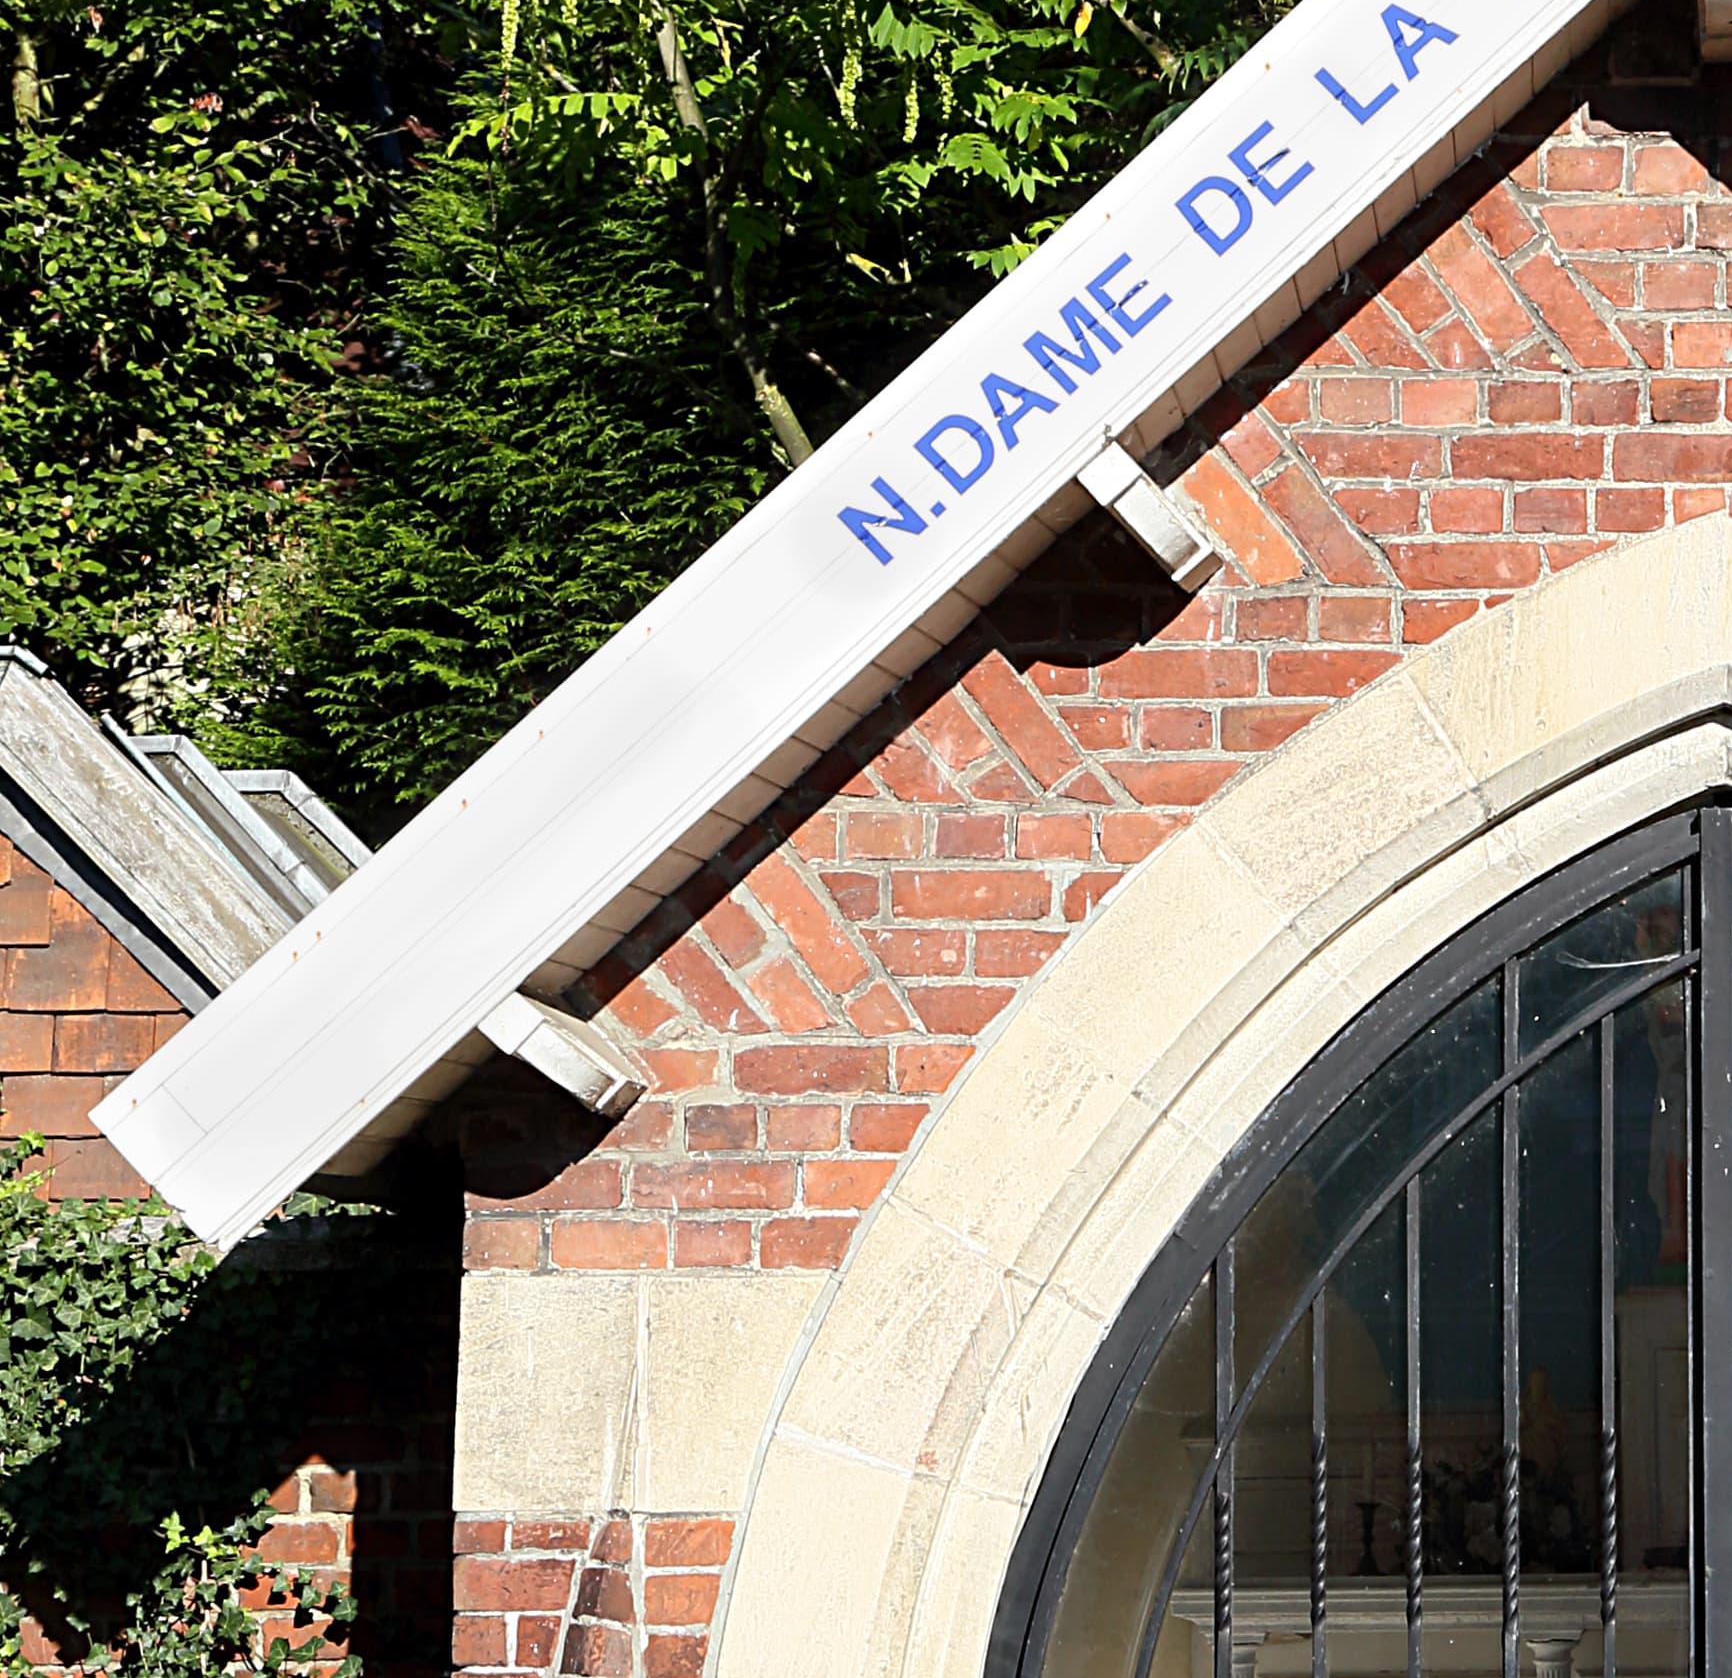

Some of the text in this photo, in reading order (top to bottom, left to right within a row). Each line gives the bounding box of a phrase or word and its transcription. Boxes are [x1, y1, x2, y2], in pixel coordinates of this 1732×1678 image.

[837, 252, 1172, 565] N.DAME
[1175, 120, 1314, 256] DE
[1314, 3, 1458, 124] LA
